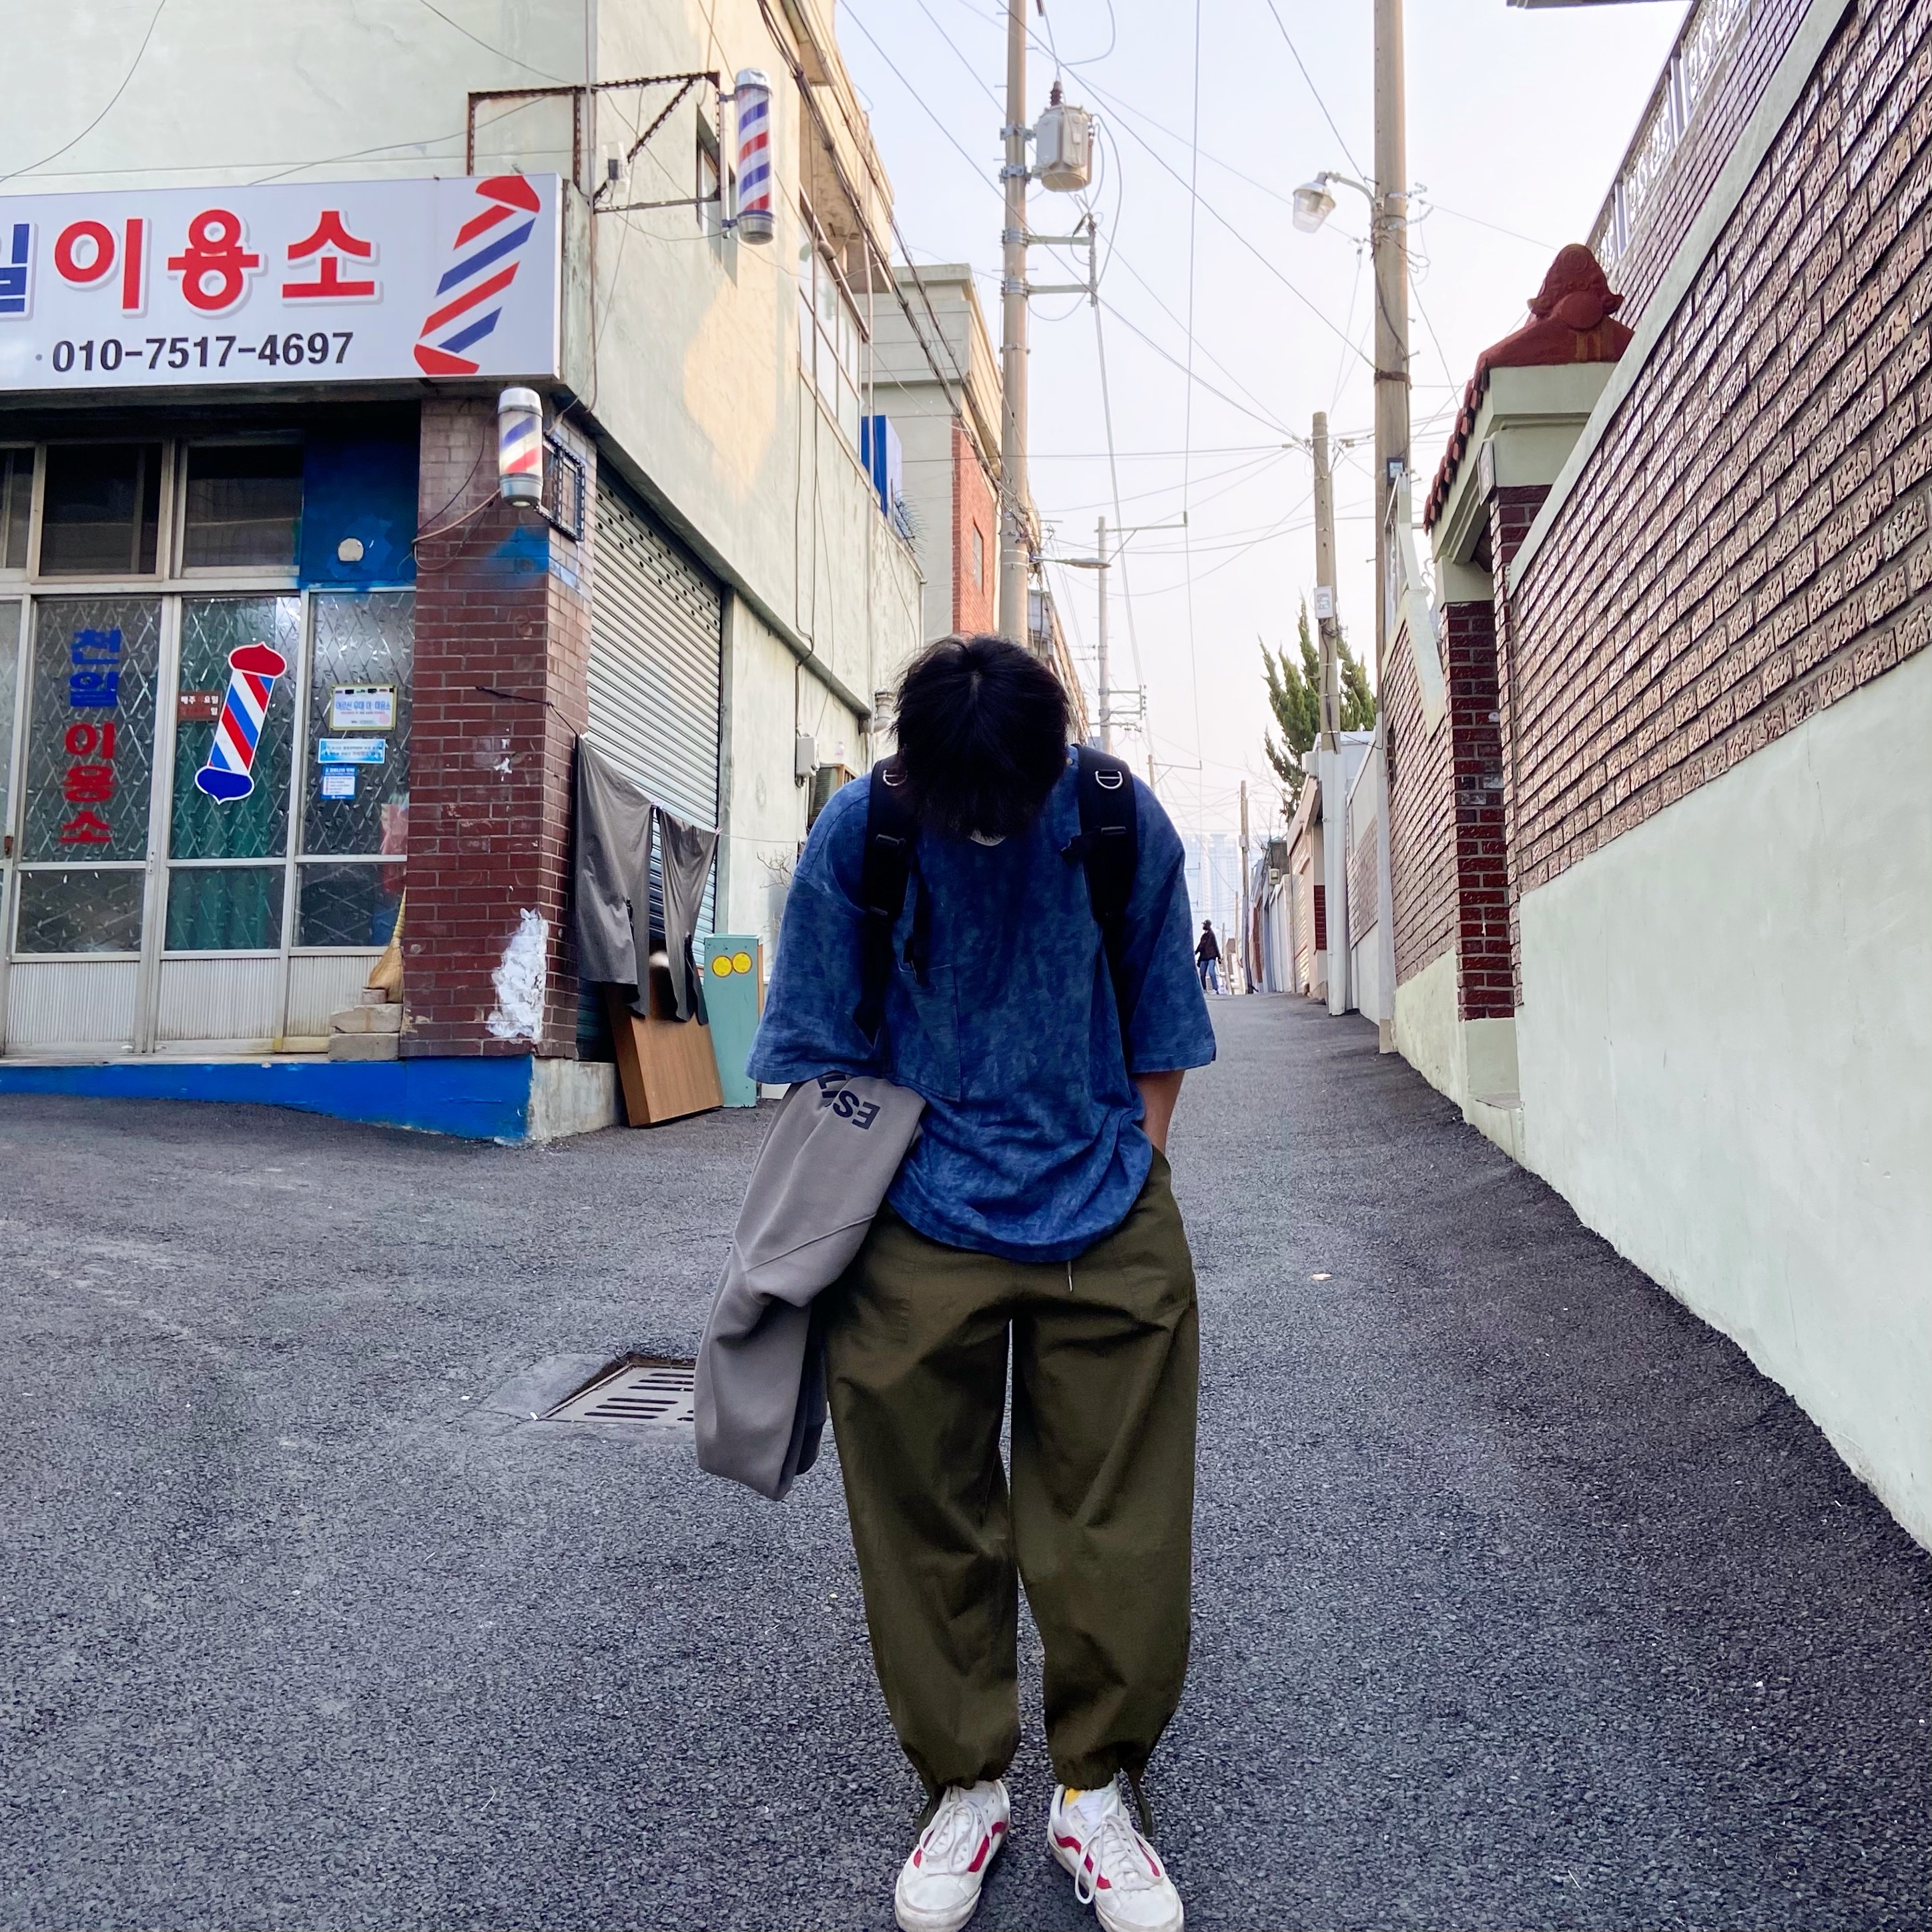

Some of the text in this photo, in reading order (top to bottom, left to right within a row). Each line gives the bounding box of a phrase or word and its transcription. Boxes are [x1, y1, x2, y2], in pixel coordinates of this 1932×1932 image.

[55, 208, 376, 311] 이용소
[53, 332, 354, 372] 010-7517-4697
[59, 721, 115, 844] 이용소
